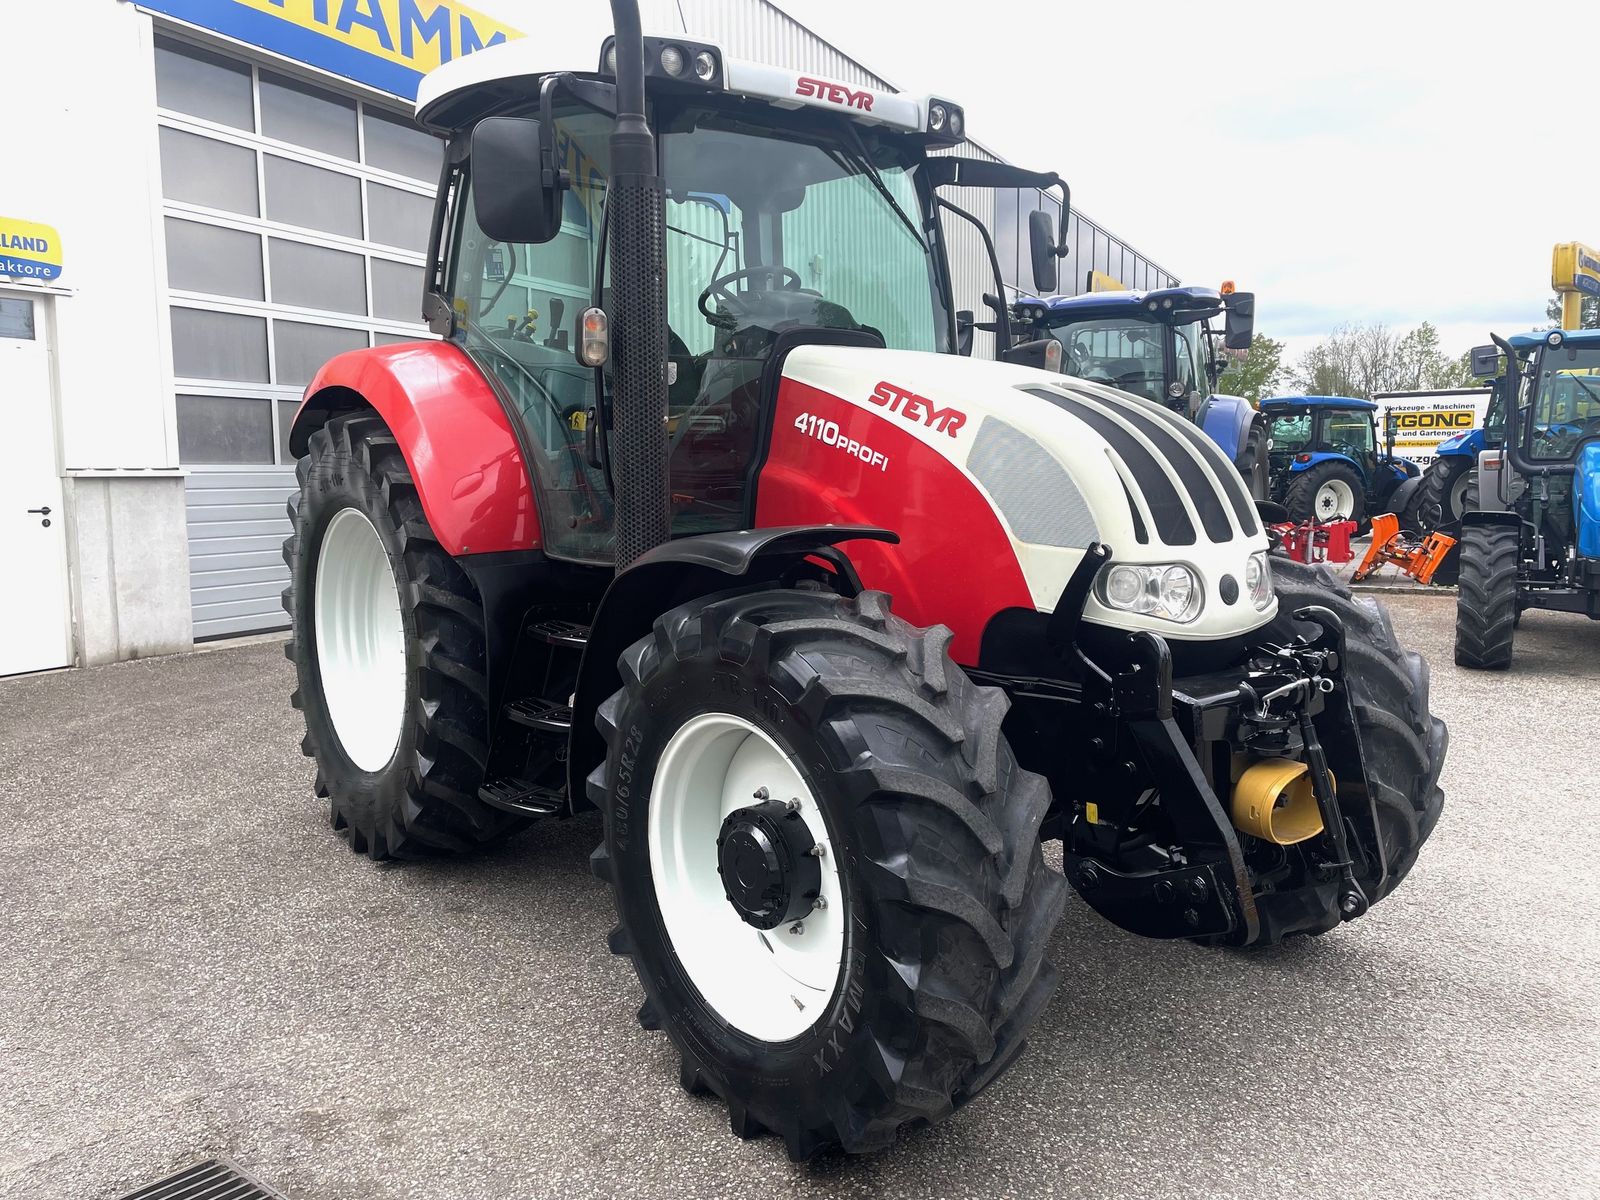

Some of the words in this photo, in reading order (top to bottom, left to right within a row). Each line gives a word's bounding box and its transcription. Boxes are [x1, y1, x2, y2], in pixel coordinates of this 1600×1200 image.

[268, 0, 506, 66] AMM
[795, 76, 874, 112] STEYR
[0, 233, 48, 253] LAND
[867, 380, 968, 438] STEYR
[1384, 404, 1425, 412] Werkzeuge
[1419, 429, 1463, 437] Gartenger
